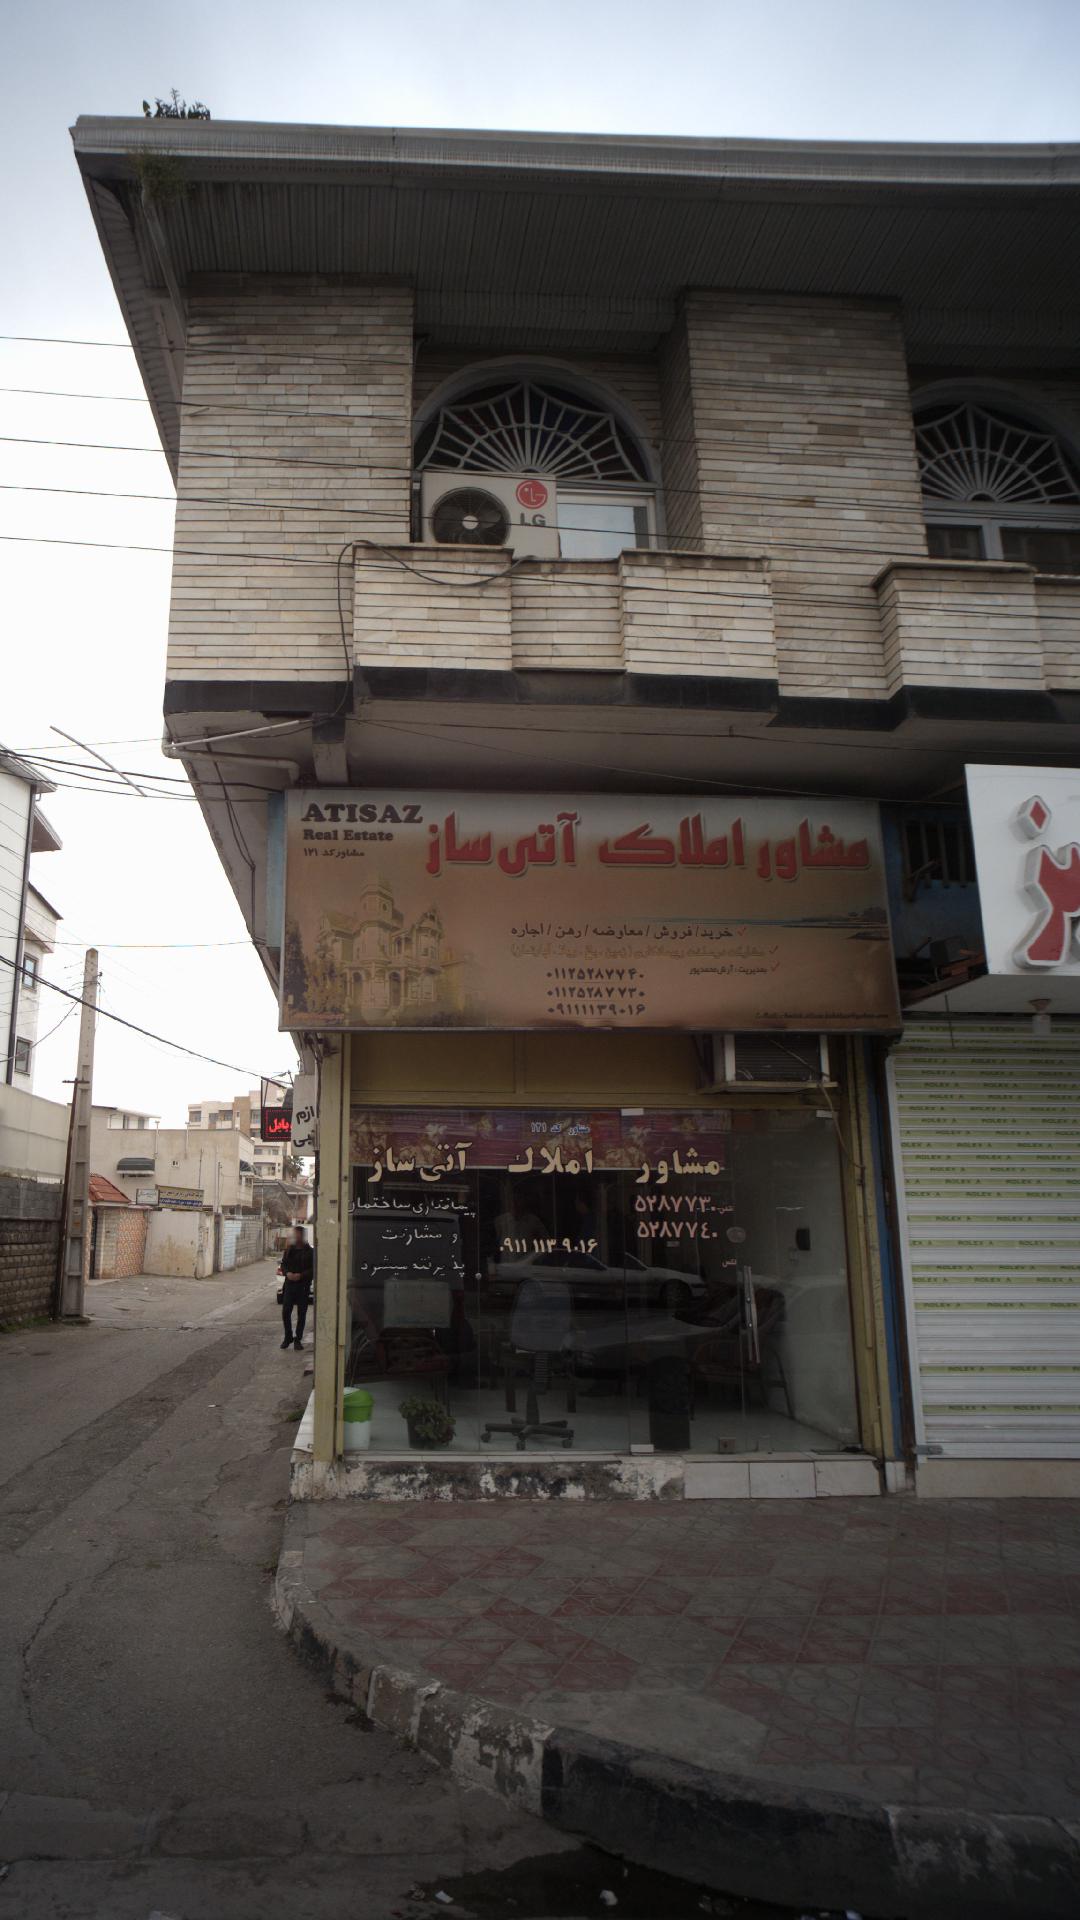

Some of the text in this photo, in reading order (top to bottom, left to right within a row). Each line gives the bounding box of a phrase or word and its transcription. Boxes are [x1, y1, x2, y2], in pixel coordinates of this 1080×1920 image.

[520, 513, 546, 526] LG
[301, 803, 423, 823] ATISAZ
[303, 829, 393, 841] Real Estate
[598, 812, 746, 867] املاک
[757, 816, 869, 880] مشاور
[511, 923, 544, 937] اجاره
[635, 1147, 720, 1184] مشاور
